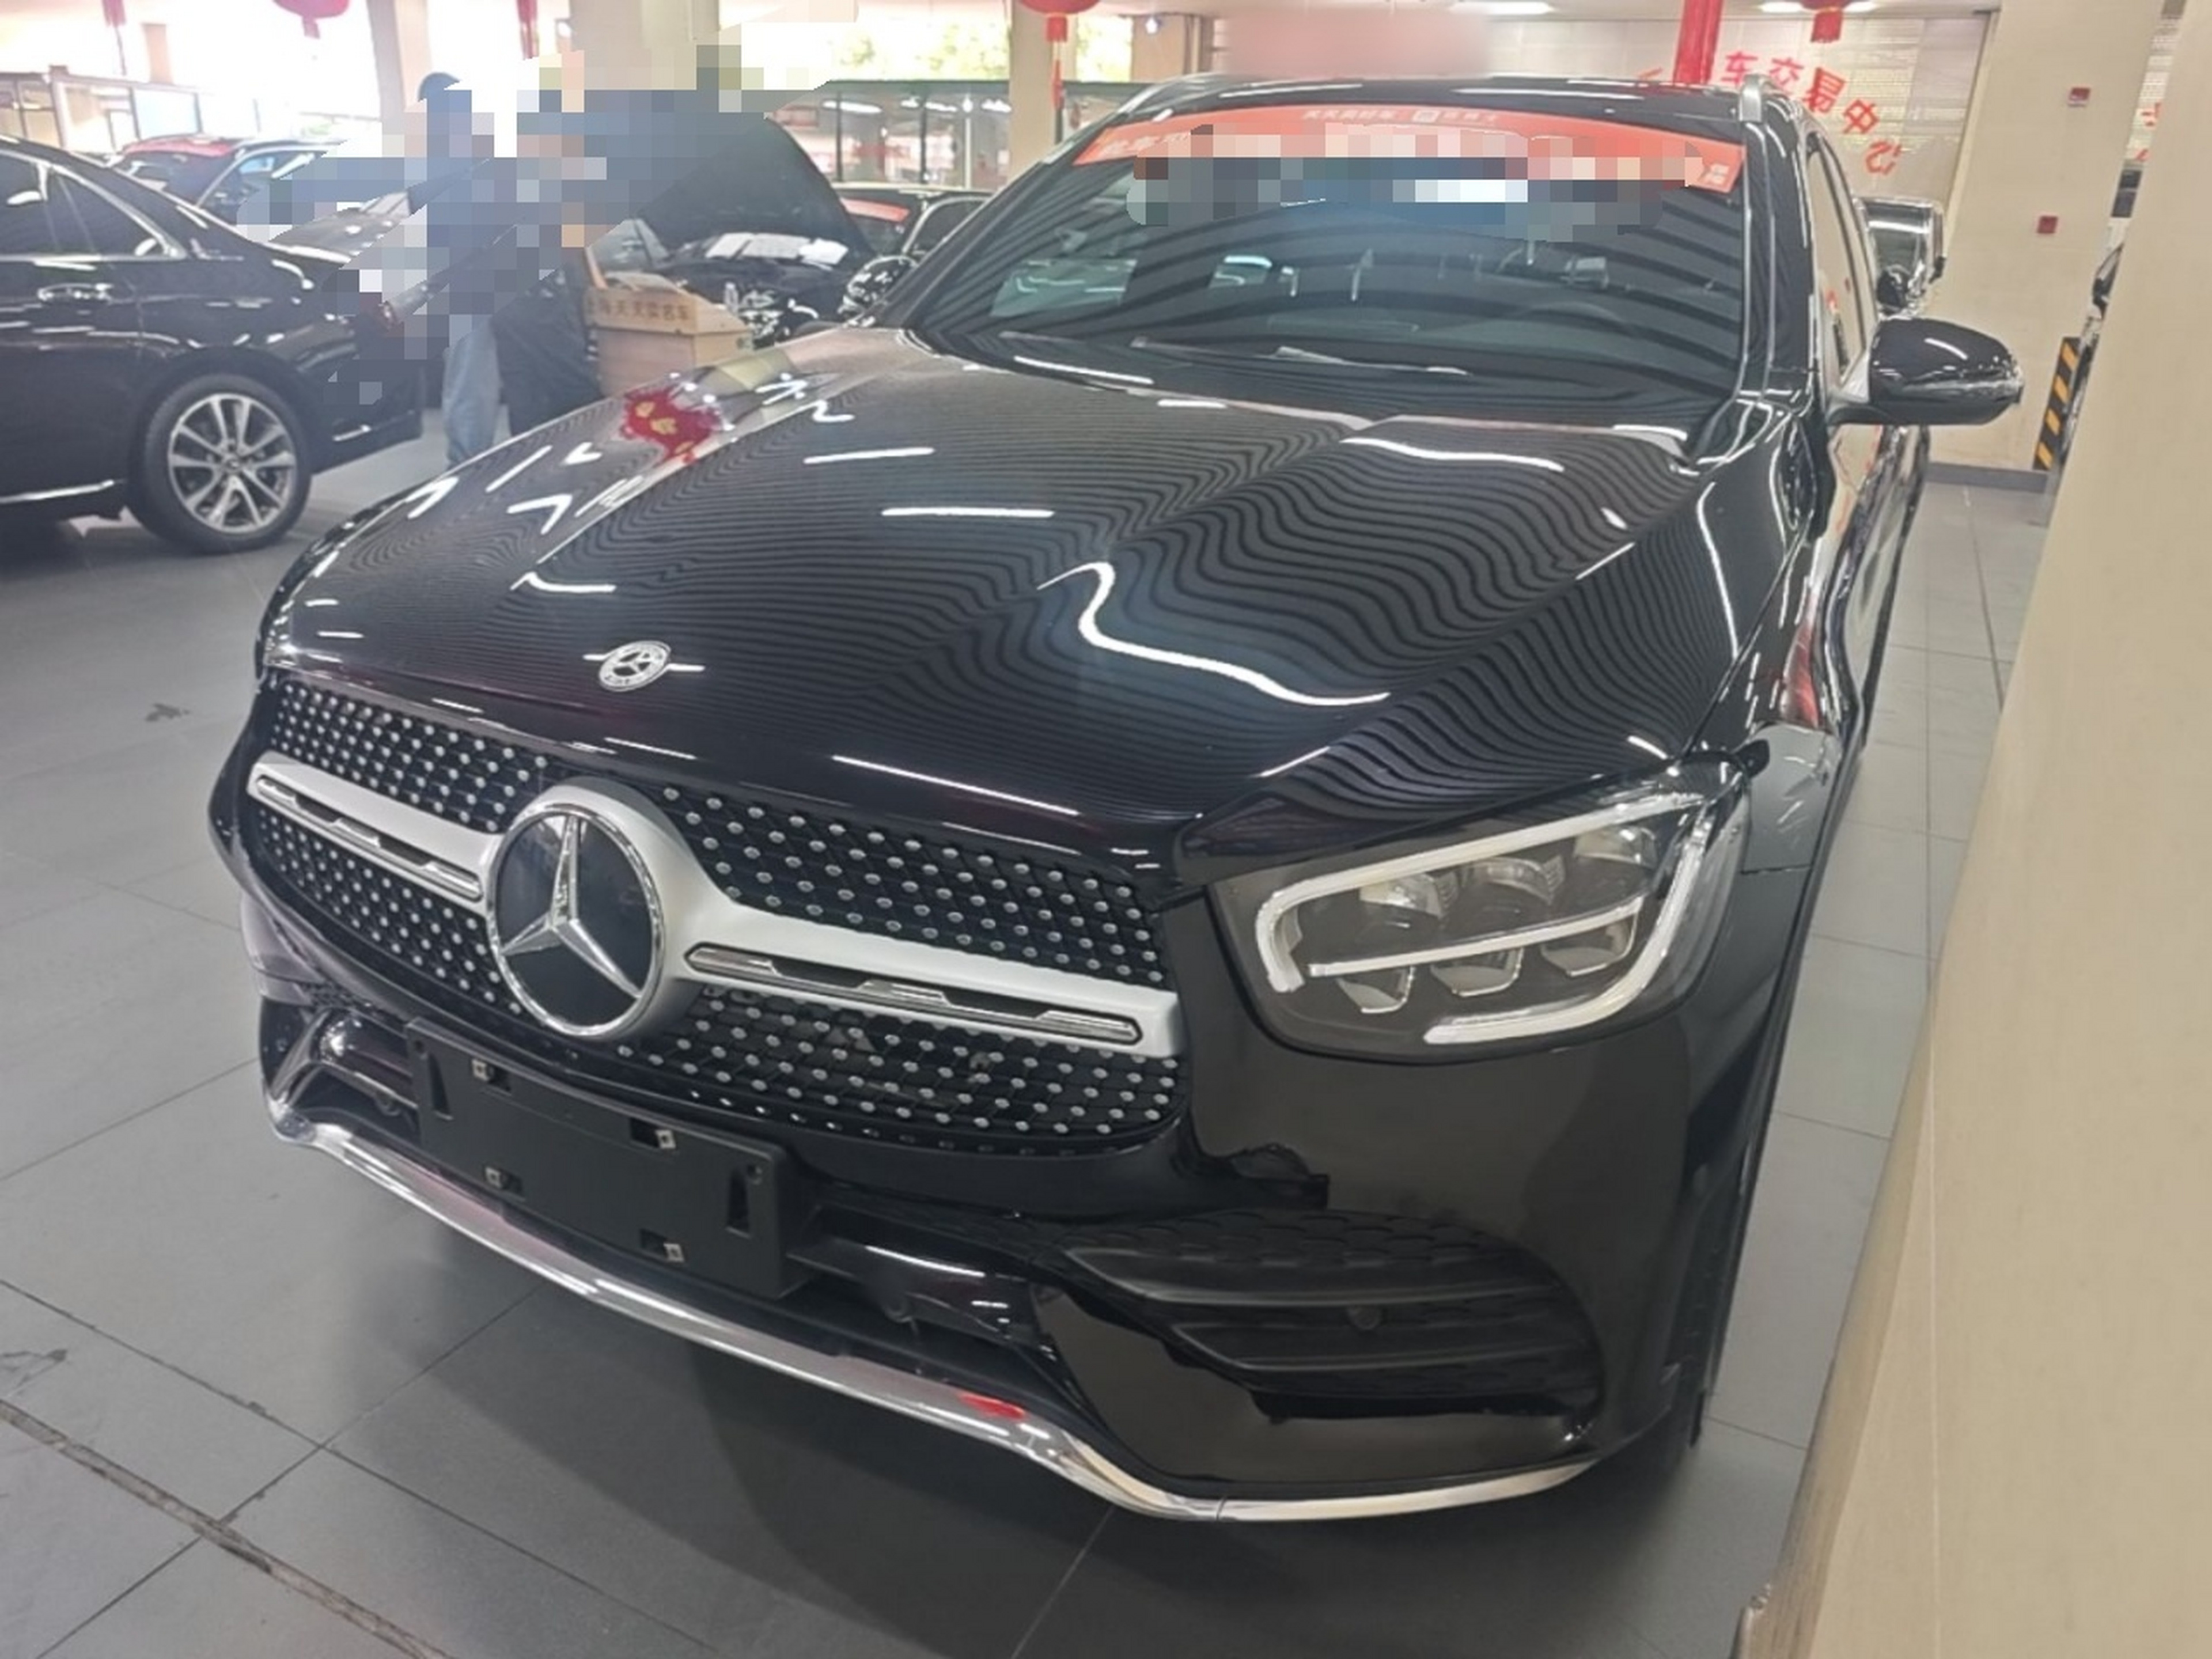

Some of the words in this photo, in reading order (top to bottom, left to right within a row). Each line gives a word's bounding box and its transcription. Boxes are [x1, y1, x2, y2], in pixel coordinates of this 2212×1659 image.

[1637, 51, 1901, 175] 车交易中心
